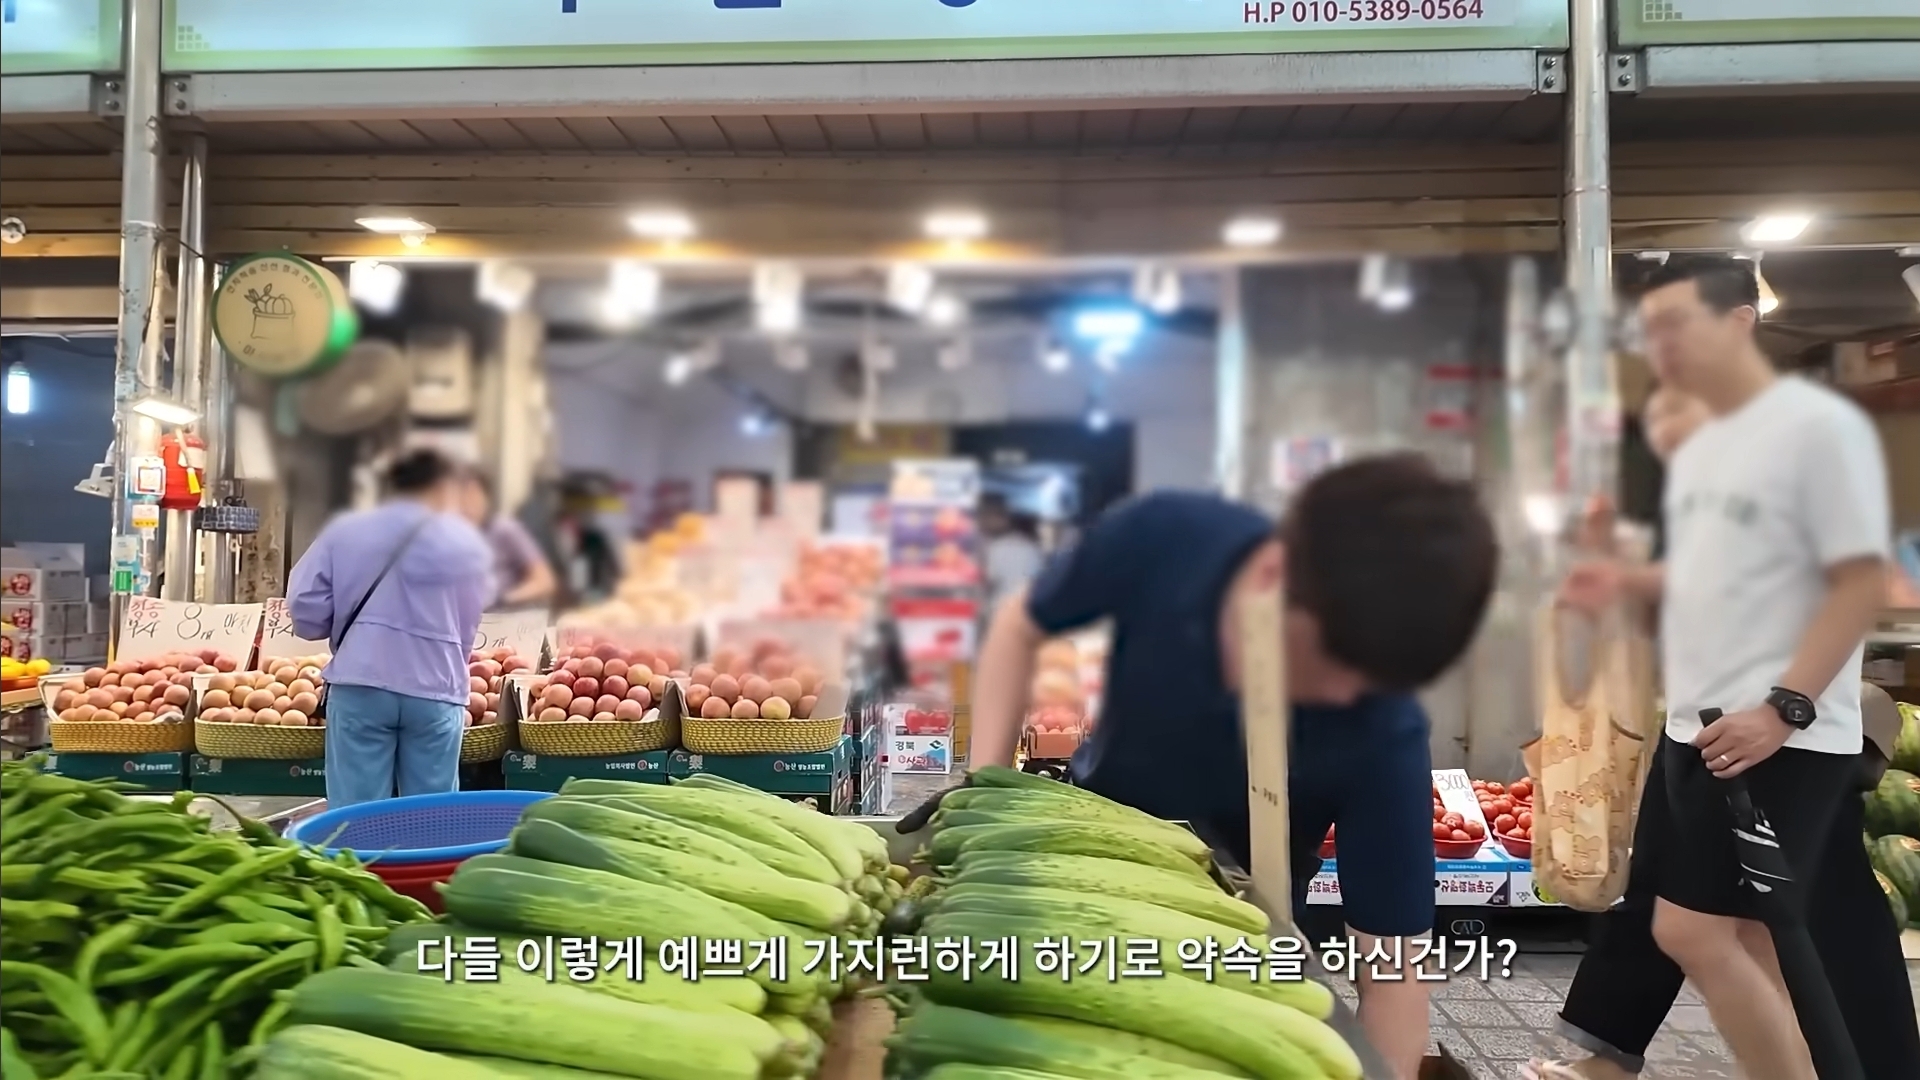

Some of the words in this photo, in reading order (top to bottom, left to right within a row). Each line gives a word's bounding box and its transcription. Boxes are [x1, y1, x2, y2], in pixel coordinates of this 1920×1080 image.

[1244, 1, 1285, 23] H.P
[1292, 0, 1484, 23] 010-5389-0564
[895, 741, 915, 751] 경북
[1434, 773, 1470, 790] 3000
